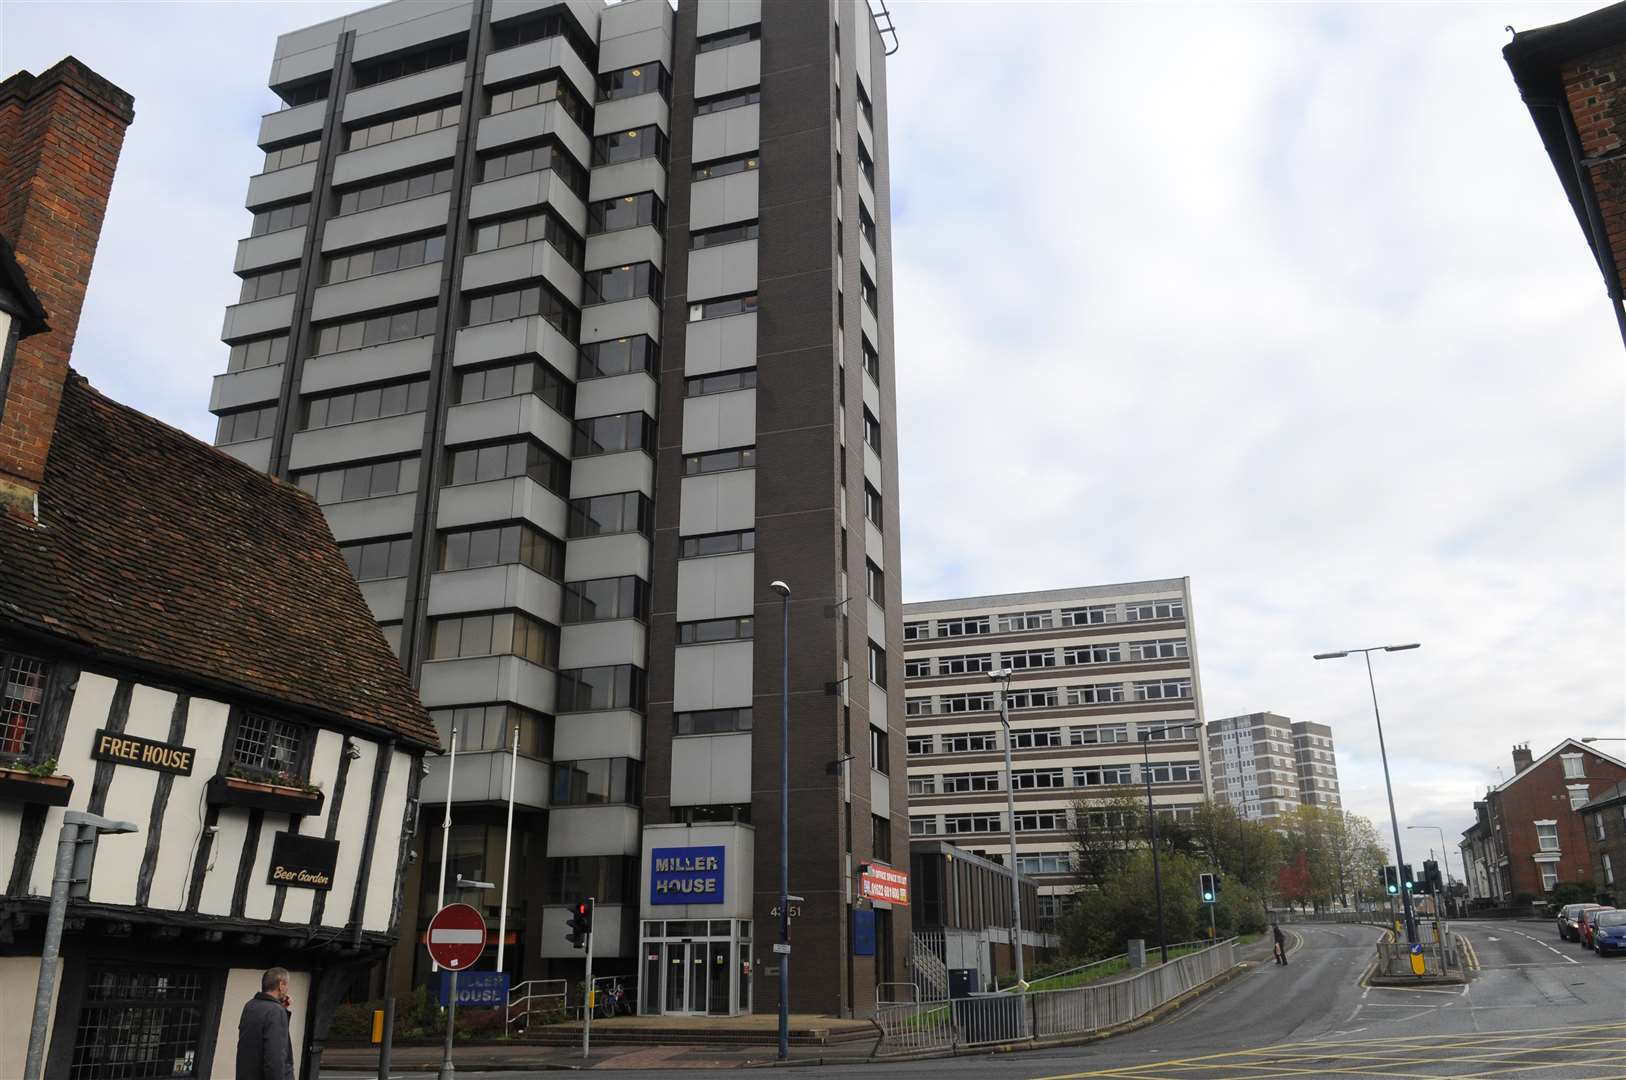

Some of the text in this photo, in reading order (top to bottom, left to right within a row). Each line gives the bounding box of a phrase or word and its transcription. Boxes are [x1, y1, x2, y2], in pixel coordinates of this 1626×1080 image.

[100, 736, 190, 770] FREE HOUSE
[655, 856, 719, 872] MILLER
[273, 866, 329, 884] Beer Garden
[656, 878, 716, 893] HOUSE
